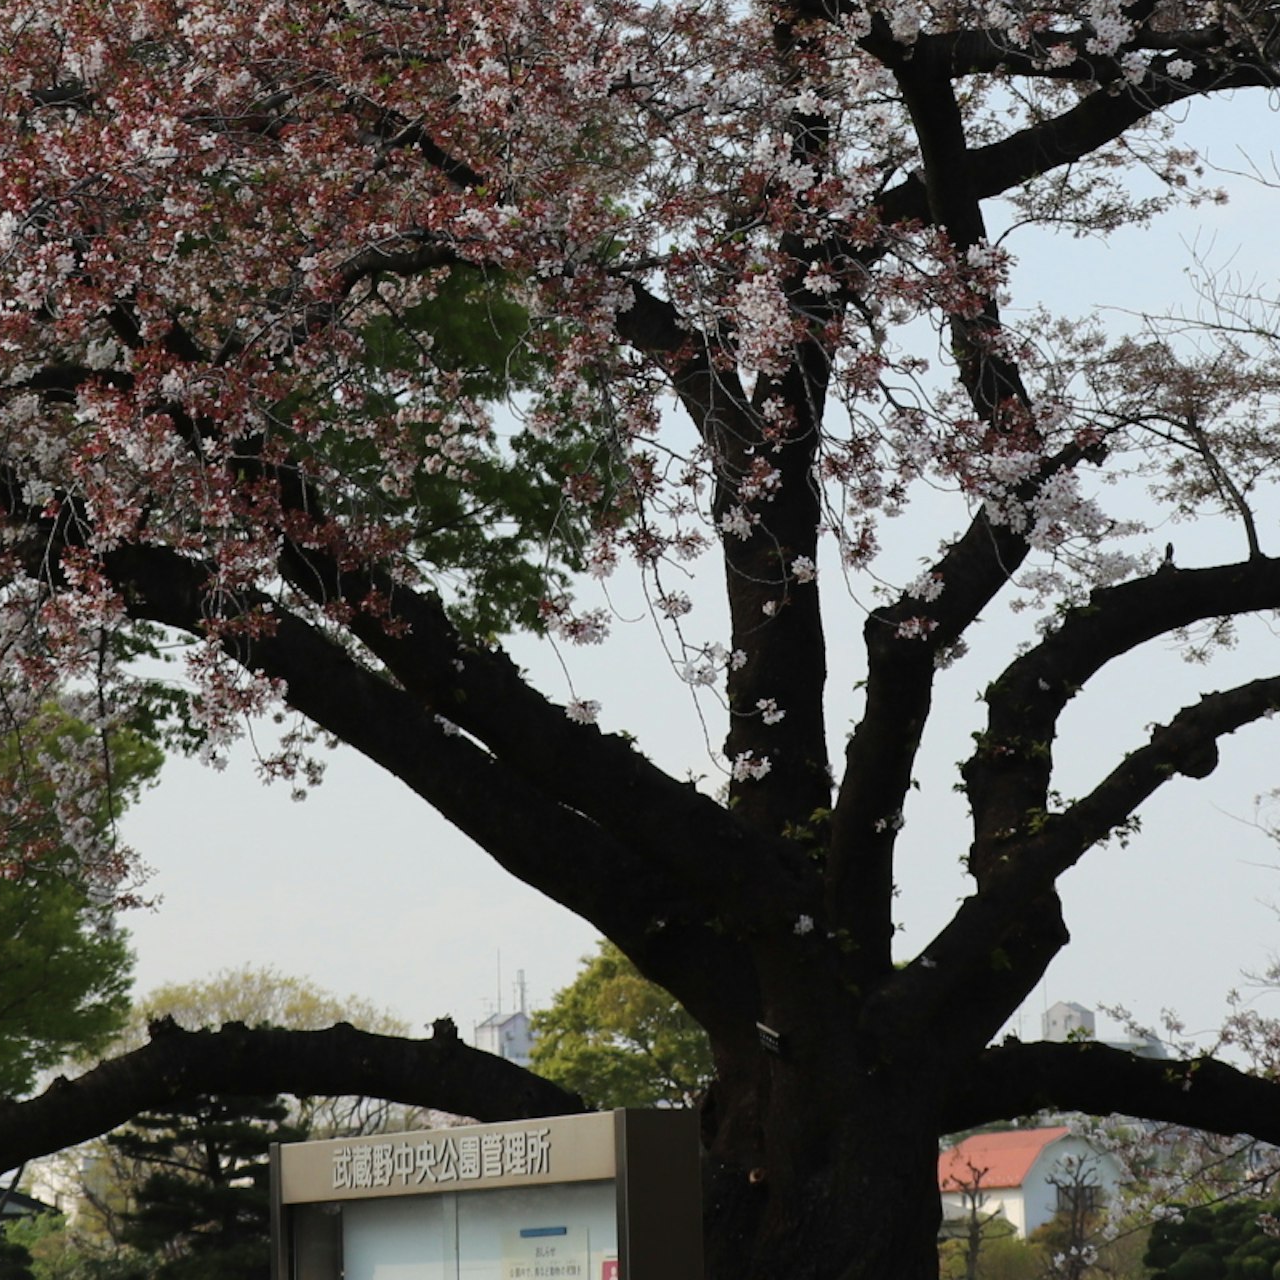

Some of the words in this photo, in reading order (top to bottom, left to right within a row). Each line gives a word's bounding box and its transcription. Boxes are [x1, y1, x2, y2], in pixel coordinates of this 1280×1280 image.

[332, 1128, 551, 1189] 武蔵野中央公園管理所
